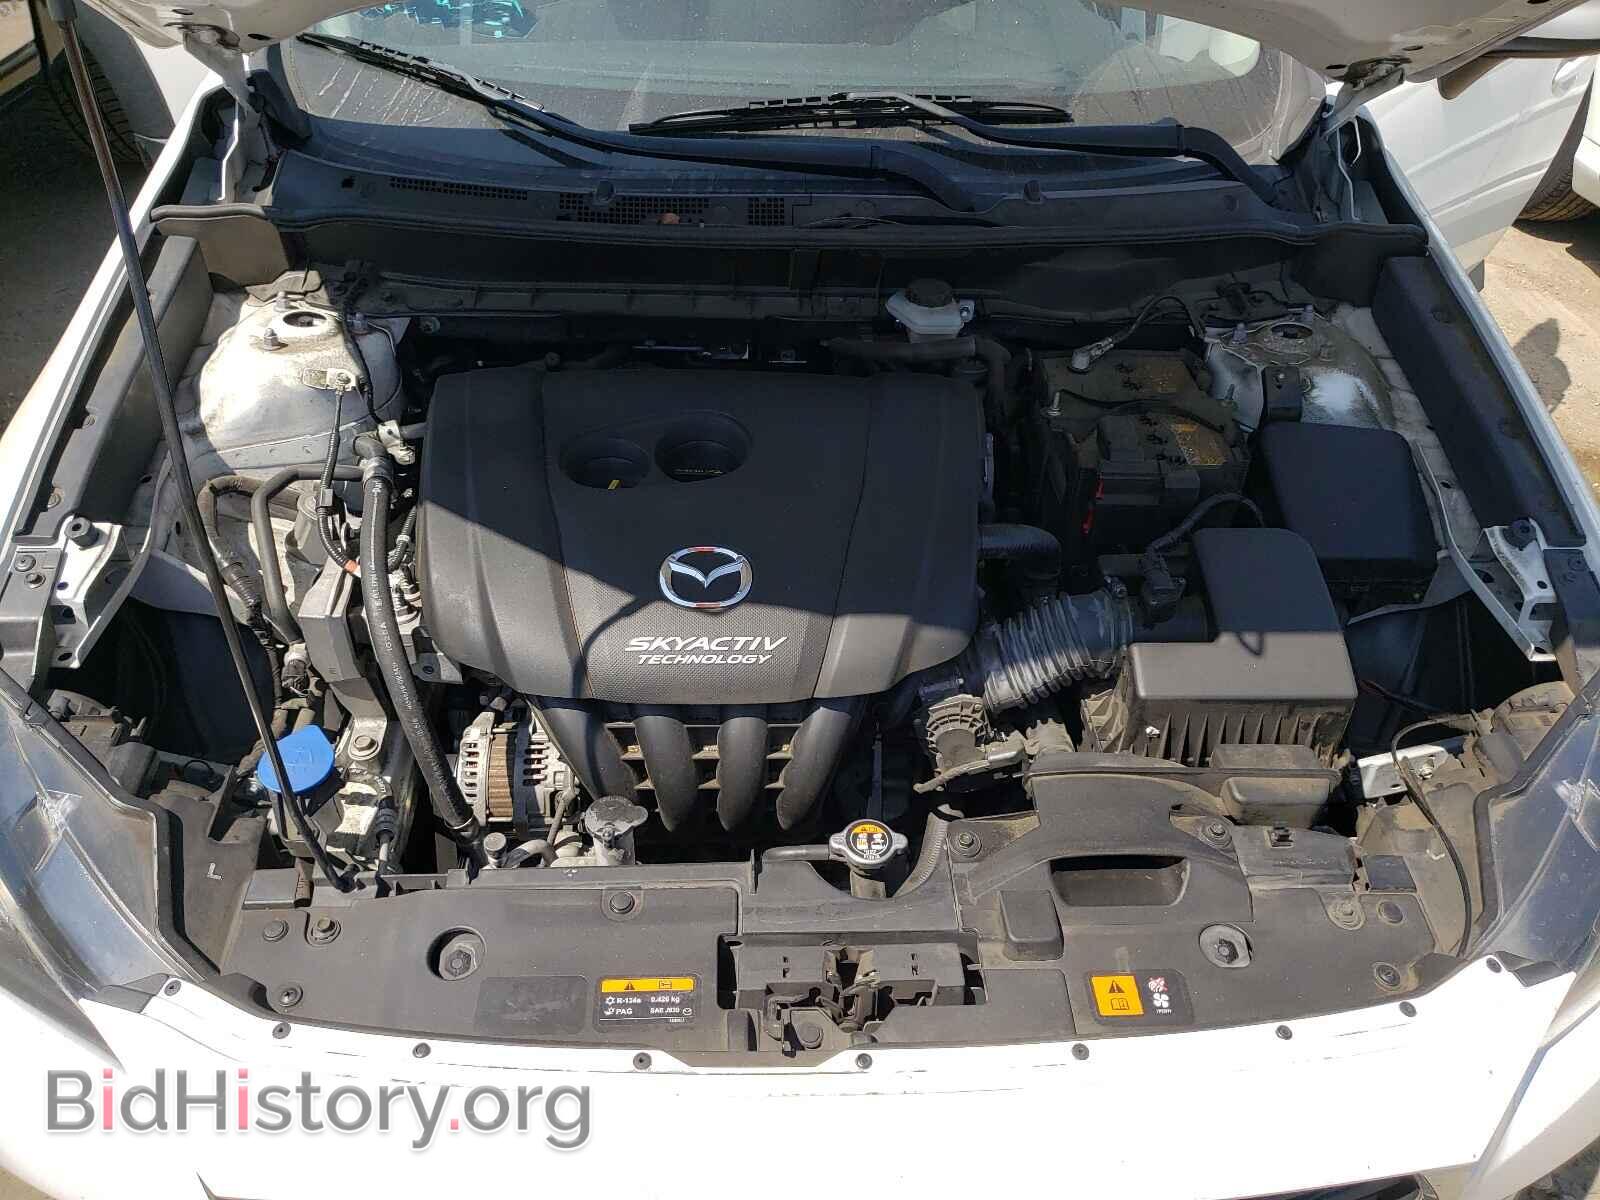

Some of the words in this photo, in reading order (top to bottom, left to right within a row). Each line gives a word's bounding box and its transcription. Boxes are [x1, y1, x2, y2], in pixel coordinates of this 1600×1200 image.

[625, 636, 788, 652] SKYACTIV
[638, 654, 772, 666] TECHNOLOGY
[616, 1007, 633, 1015] PAG
